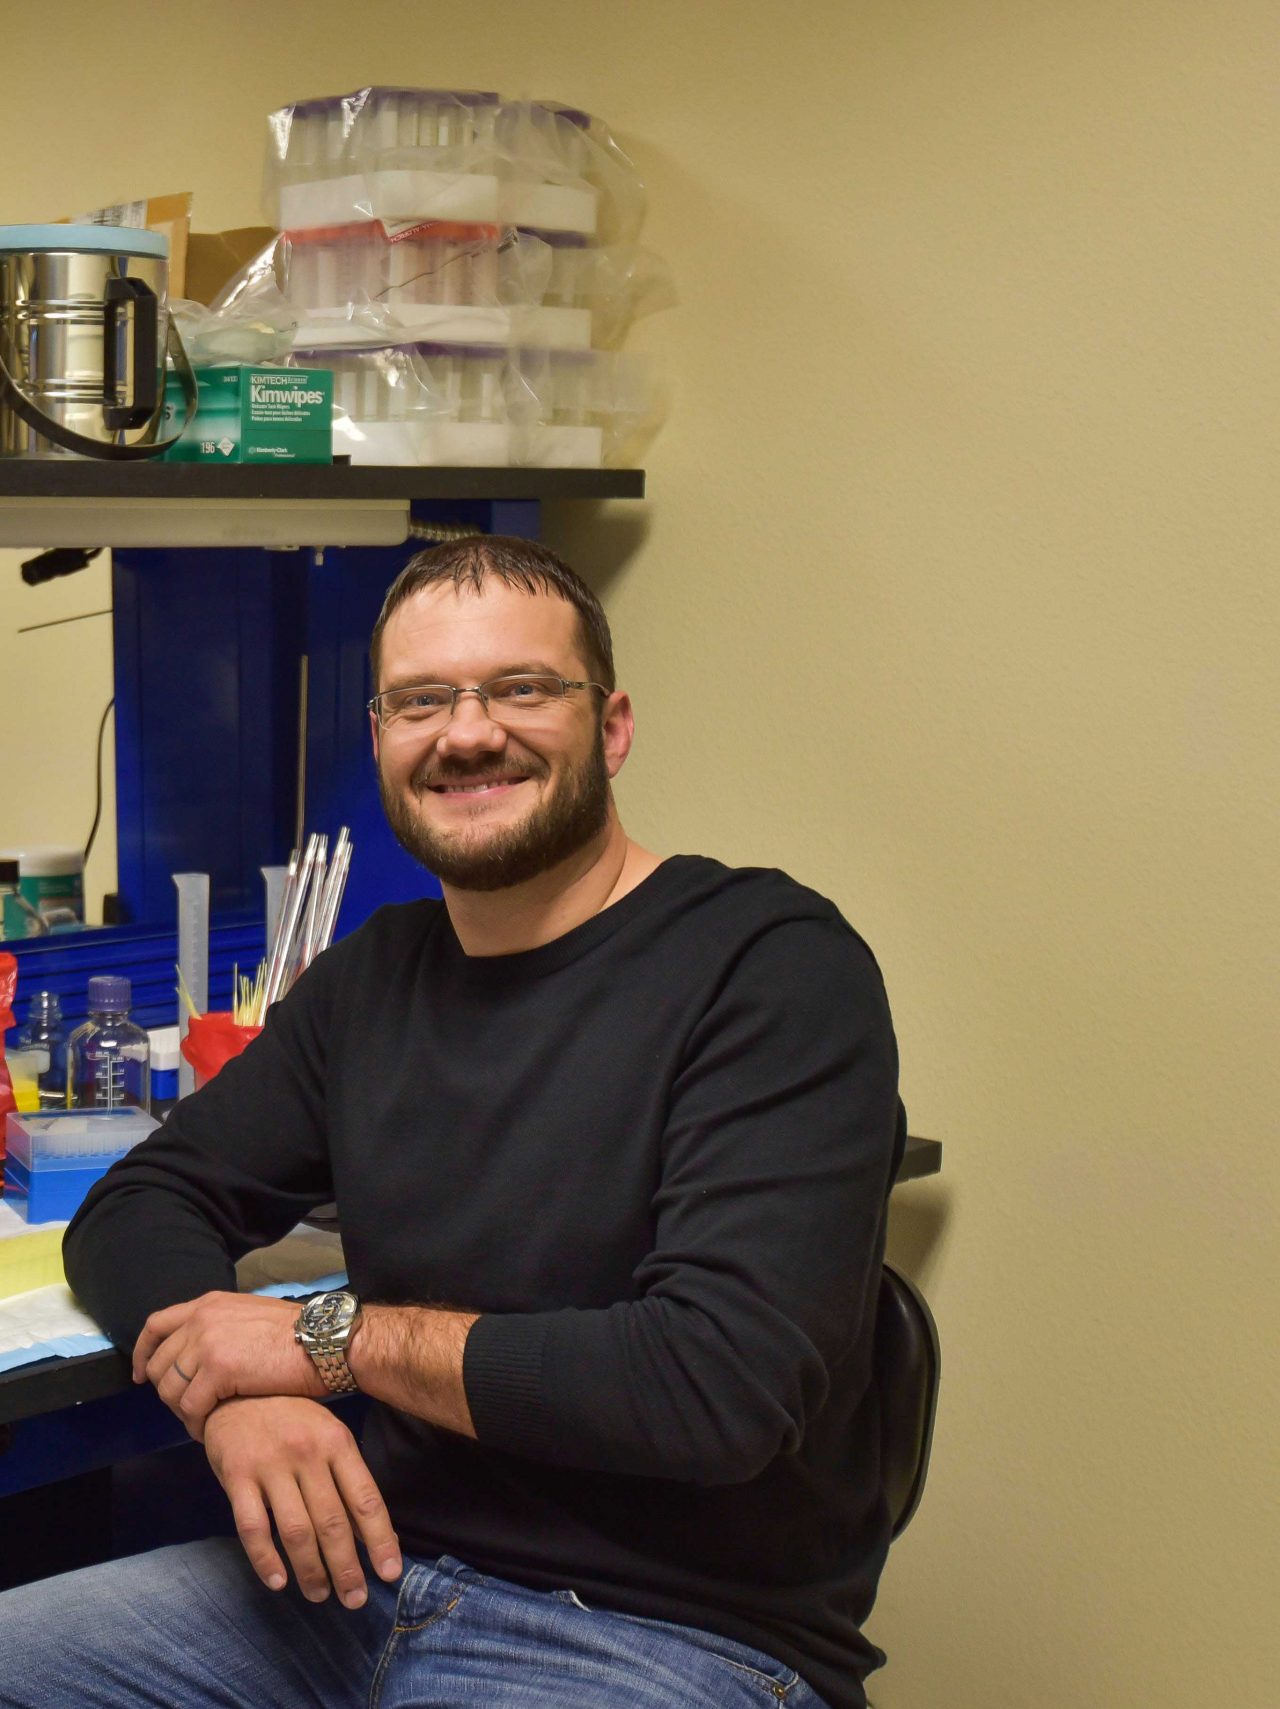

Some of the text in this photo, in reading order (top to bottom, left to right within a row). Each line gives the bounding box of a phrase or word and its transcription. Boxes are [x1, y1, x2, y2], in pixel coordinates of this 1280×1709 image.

[251, 375, 288, 385] KIMTECH
[251, 385, 323, 408] Kimwipes
[201, 442, 215, 454] 196
